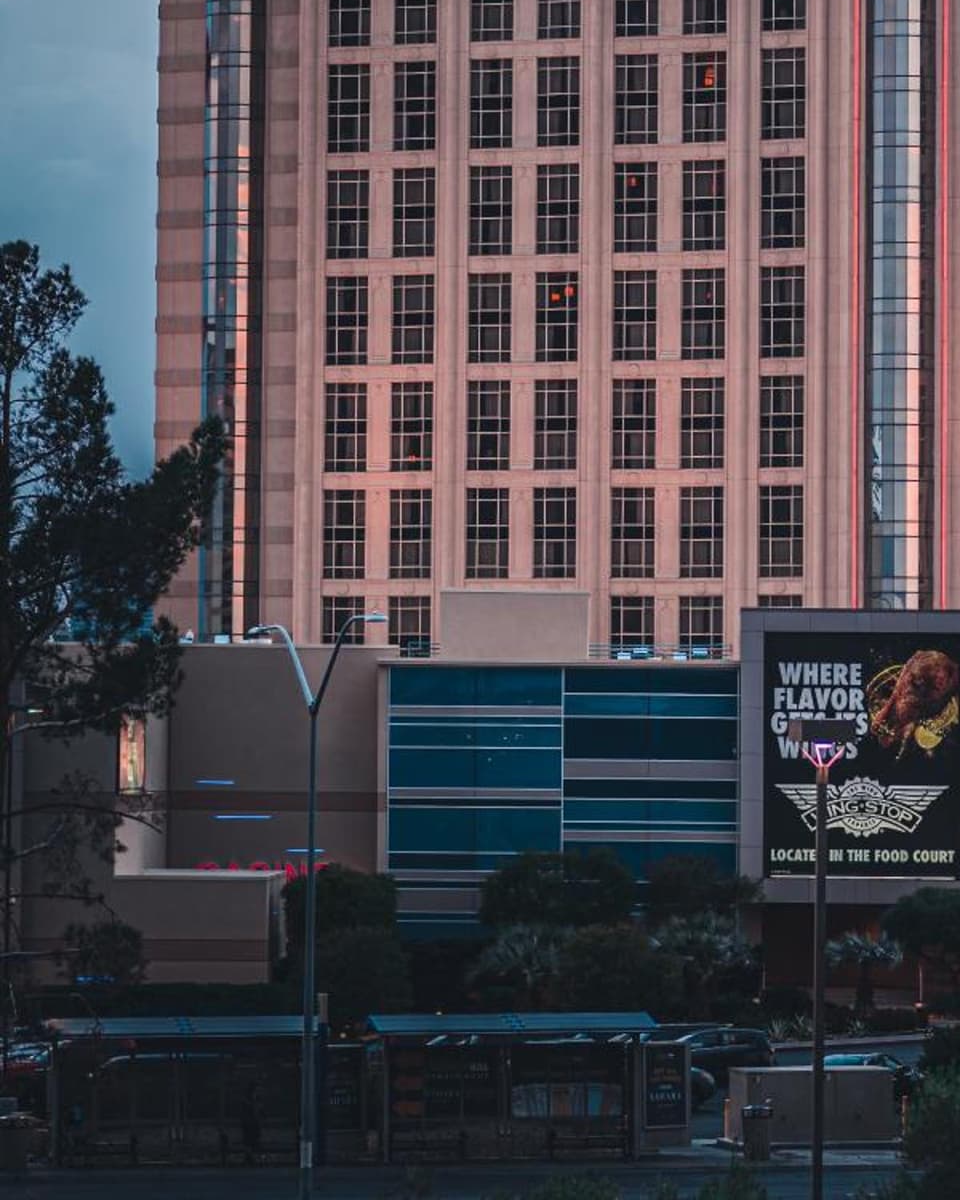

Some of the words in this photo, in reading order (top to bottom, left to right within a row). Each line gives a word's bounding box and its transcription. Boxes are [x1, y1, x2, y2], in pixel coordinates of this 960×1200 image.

[778, 662, 862, 686] WHERE
[774, 687, 865, 711] FLAVOR
[770, 849, 817, 862] LOCATE
[829, 850, 843, 863] IN
[848, 850, 870, 862] THE
[874, 850, 909, 863] FOOD
[913, 850, 956, 863] COURT
